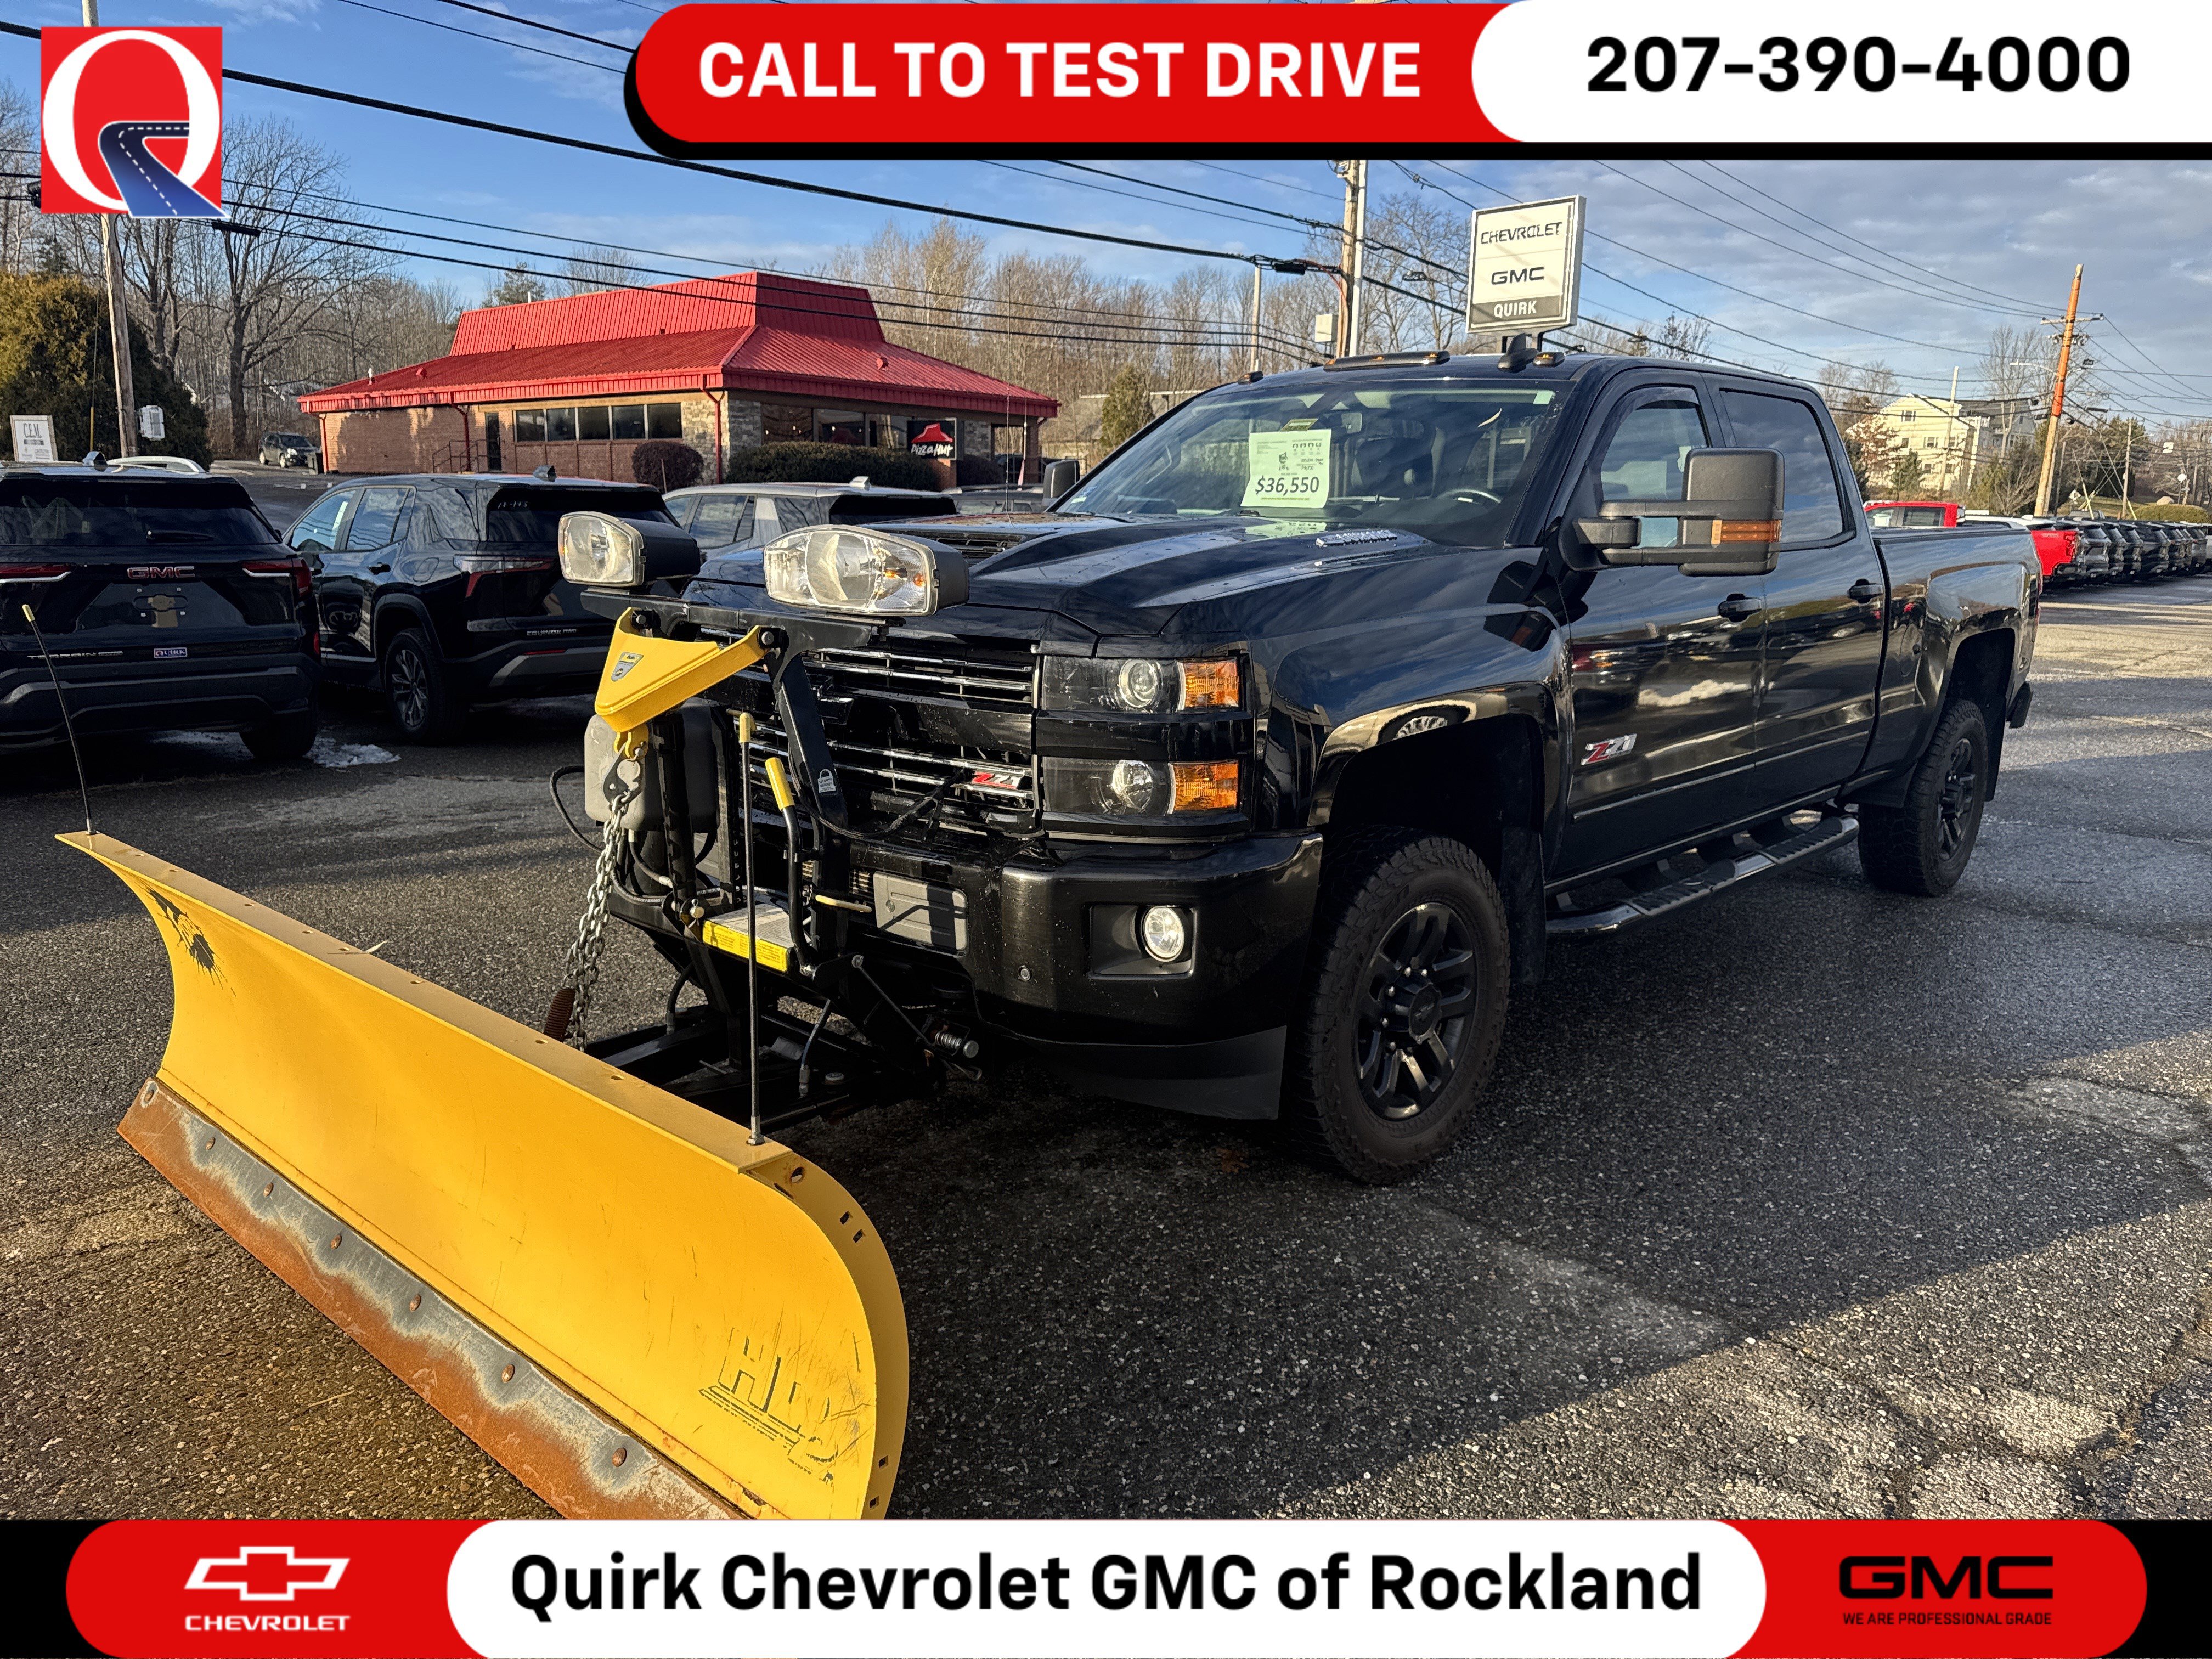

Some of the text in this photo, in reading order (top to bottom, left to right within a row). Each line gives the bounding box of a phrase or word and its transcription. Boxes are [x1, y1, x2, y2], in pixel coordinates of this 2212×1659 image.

[1481, 222, 1562, 244] CHEVROLET
[1491, 267, 1545, 285] GMC
[1493, 301, 1537, 318] QUIRK
[911, 443, 953, 457] Pizza Hut
[1255, 475, 1319, 496] $36,550
[127, 566, 195, 579] GMC
[1581, 733, 1637, 766] Z71
